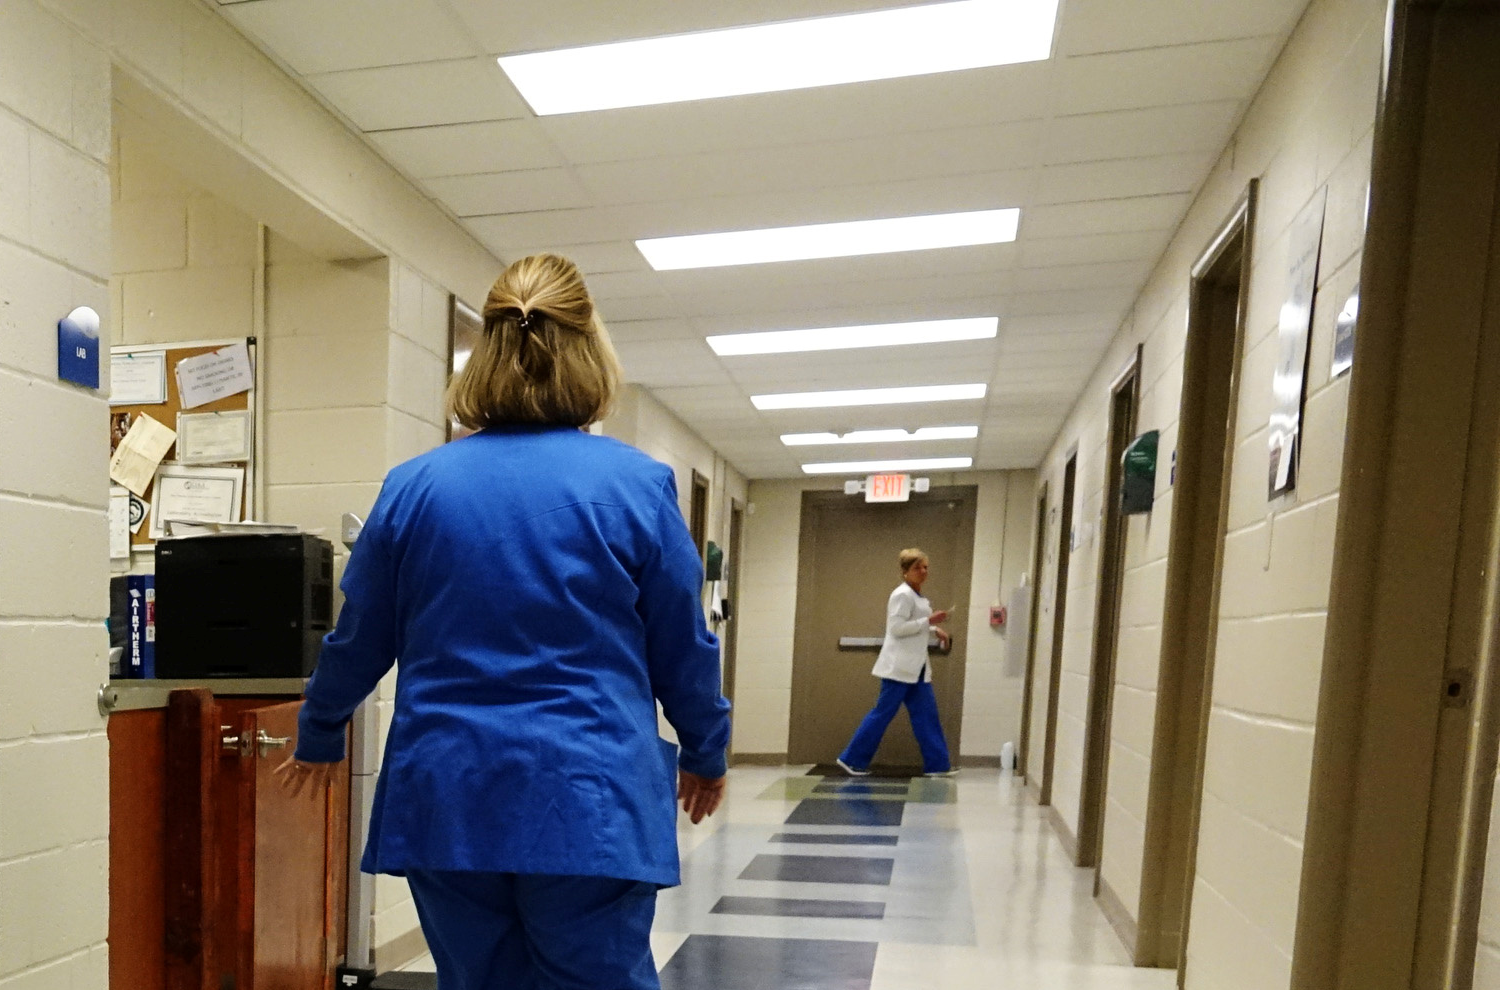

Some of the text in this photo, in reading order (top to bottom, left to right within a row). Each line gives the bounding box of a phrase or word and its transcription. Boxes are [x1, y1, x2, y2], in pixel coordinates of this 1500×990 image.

[76, 346, 87, 359] LAB
[873, 474, 906, 497] EXIT
[132, 598, 141, 666] AIRTHERM
